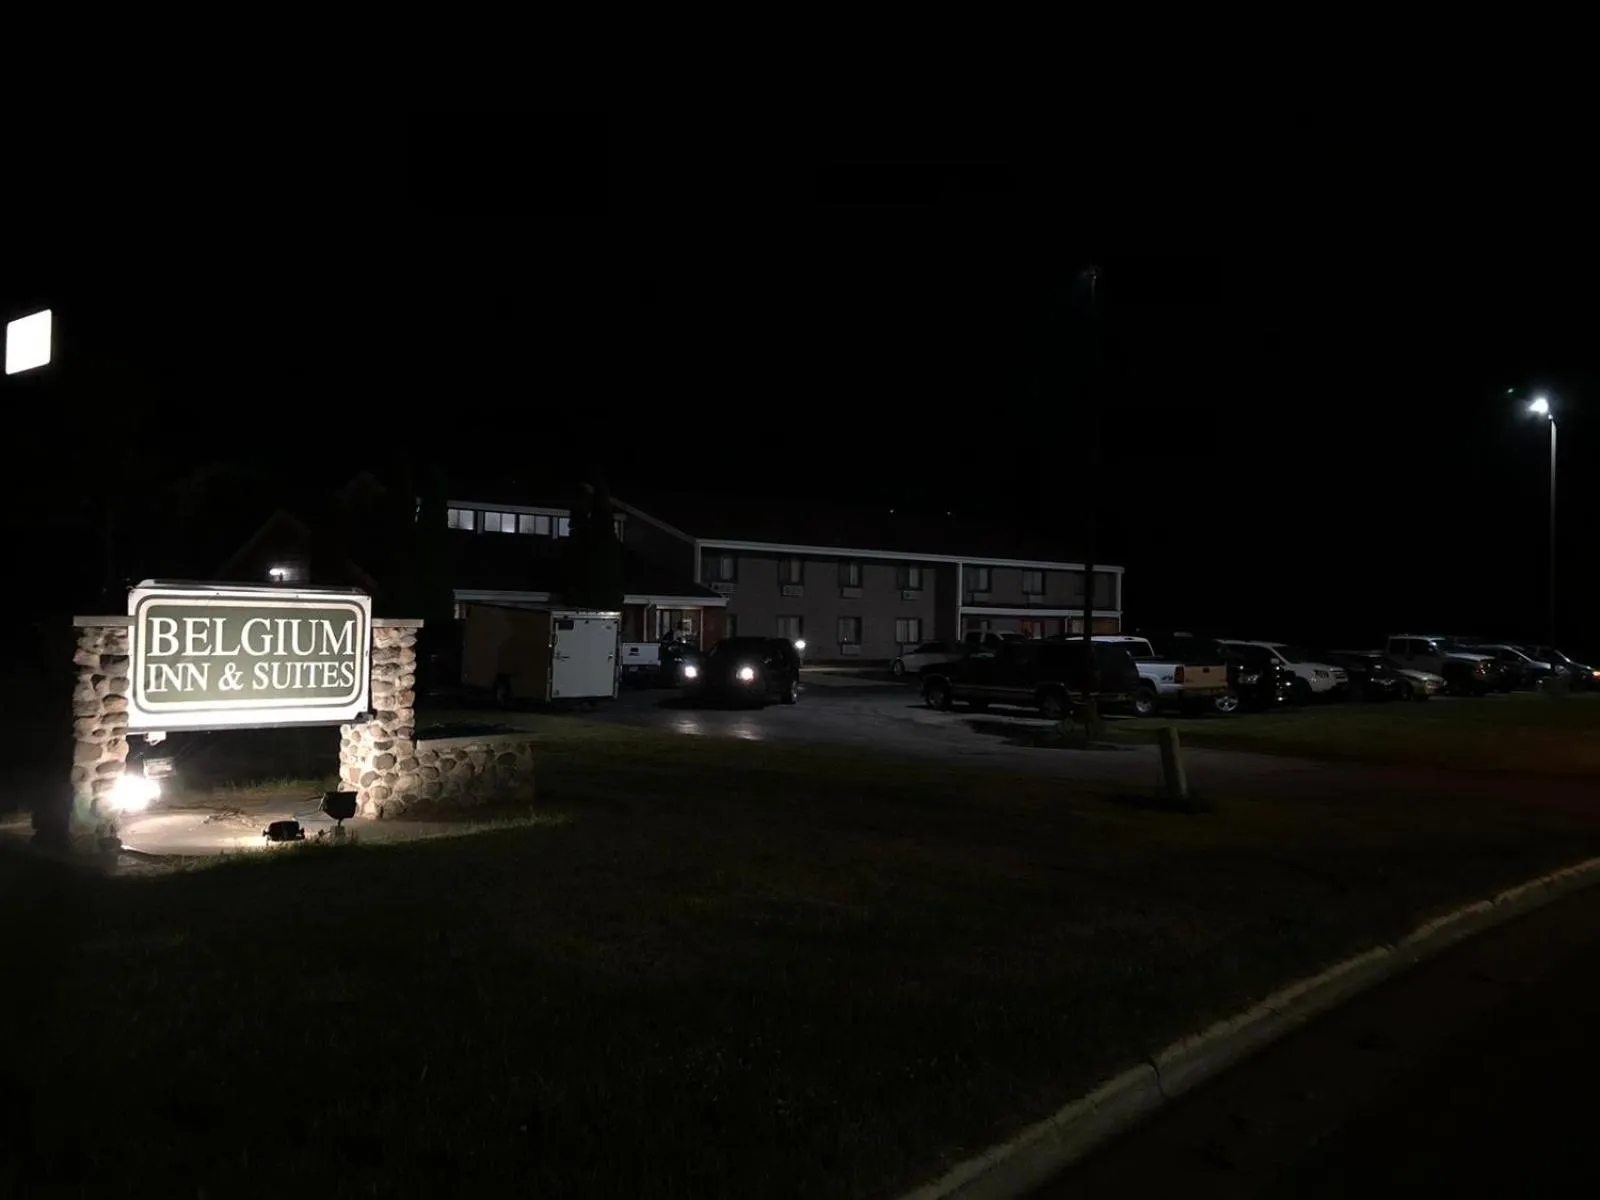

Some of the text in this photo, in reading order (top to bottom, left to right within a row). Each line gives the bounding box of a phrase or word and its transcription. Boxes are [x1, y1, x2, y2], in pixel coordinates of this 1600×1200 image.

[147, 617, 356, 657] BELGIUM
[147, 661, 355, 693] INN & SUITES
